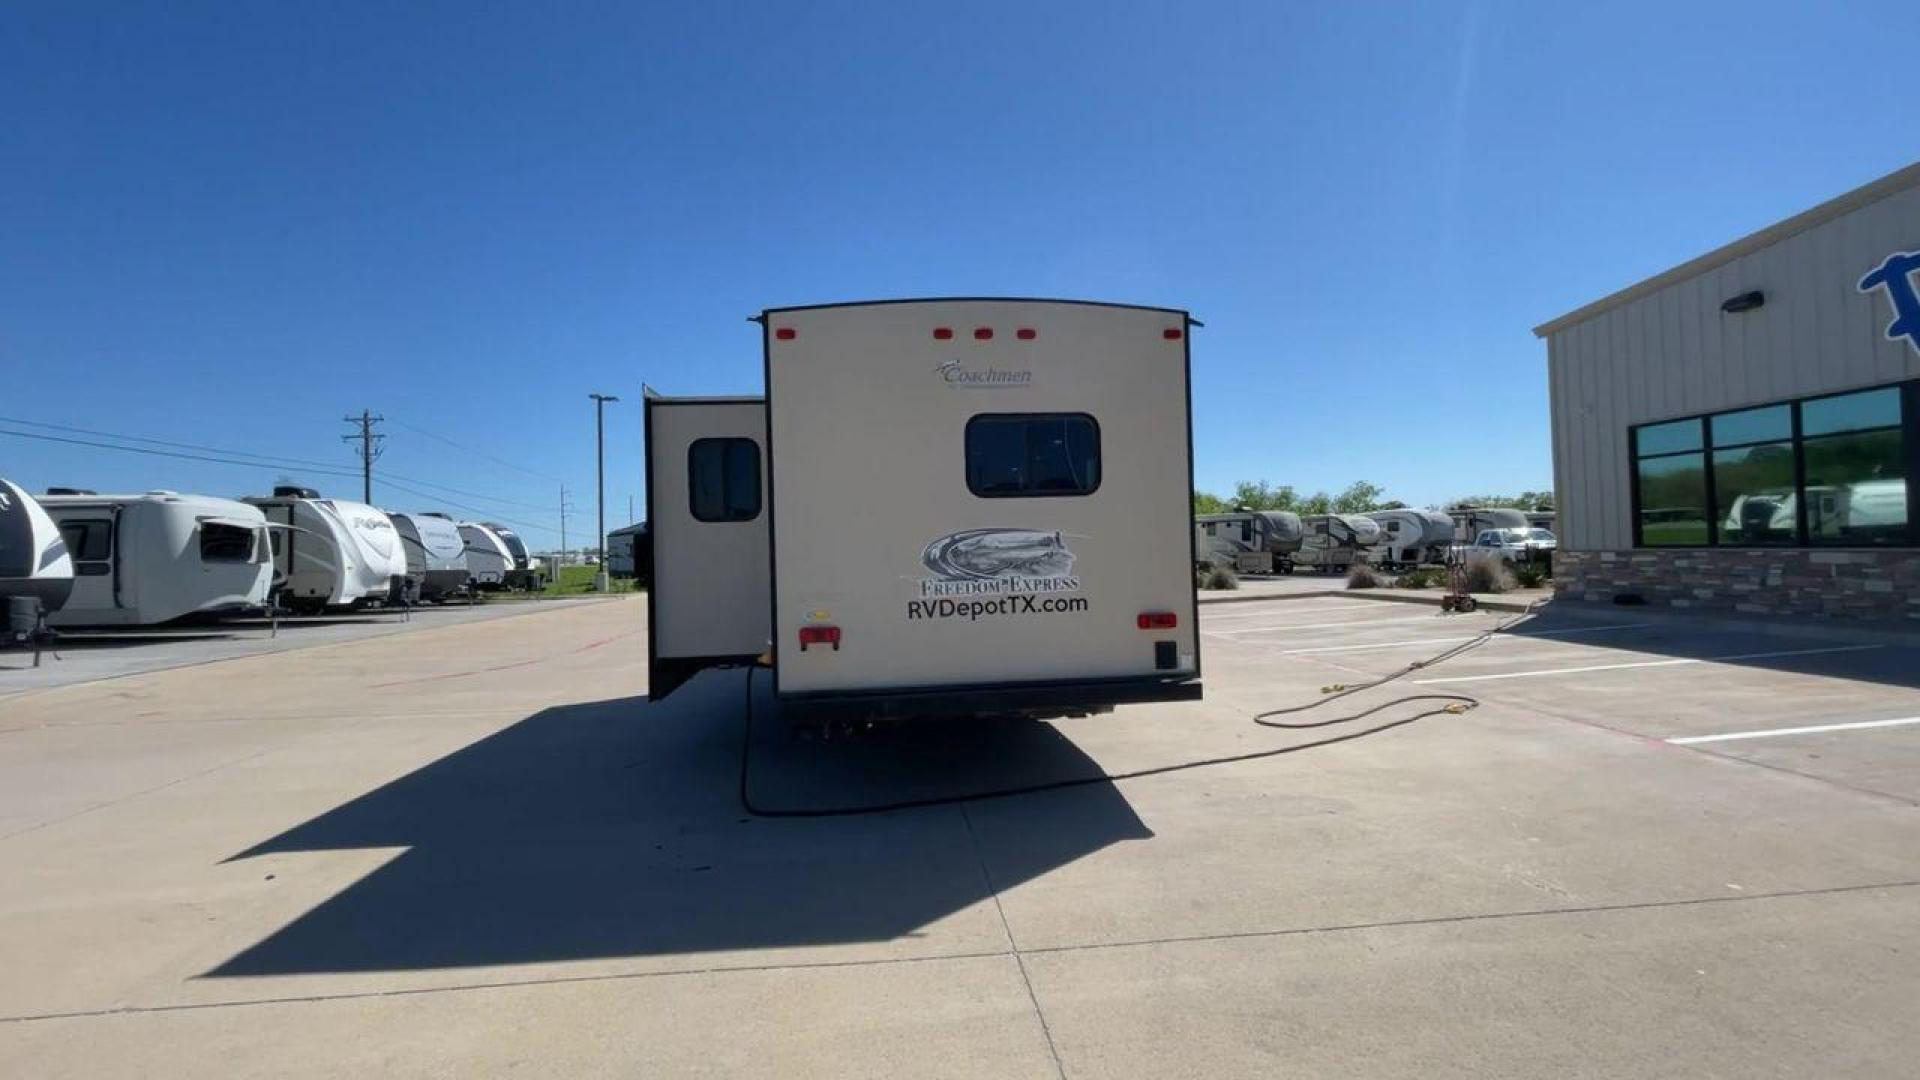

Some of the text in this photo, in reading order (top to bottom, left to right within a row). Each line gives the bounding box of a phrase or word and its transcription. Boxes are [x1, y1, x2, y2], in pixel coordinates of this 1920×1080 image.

[943, 363, 1032, 383] Coachmen
[1010, 575, 1079, 593] EXPRESS
[908, 595, 1089, 621] RVDepotTX.com
